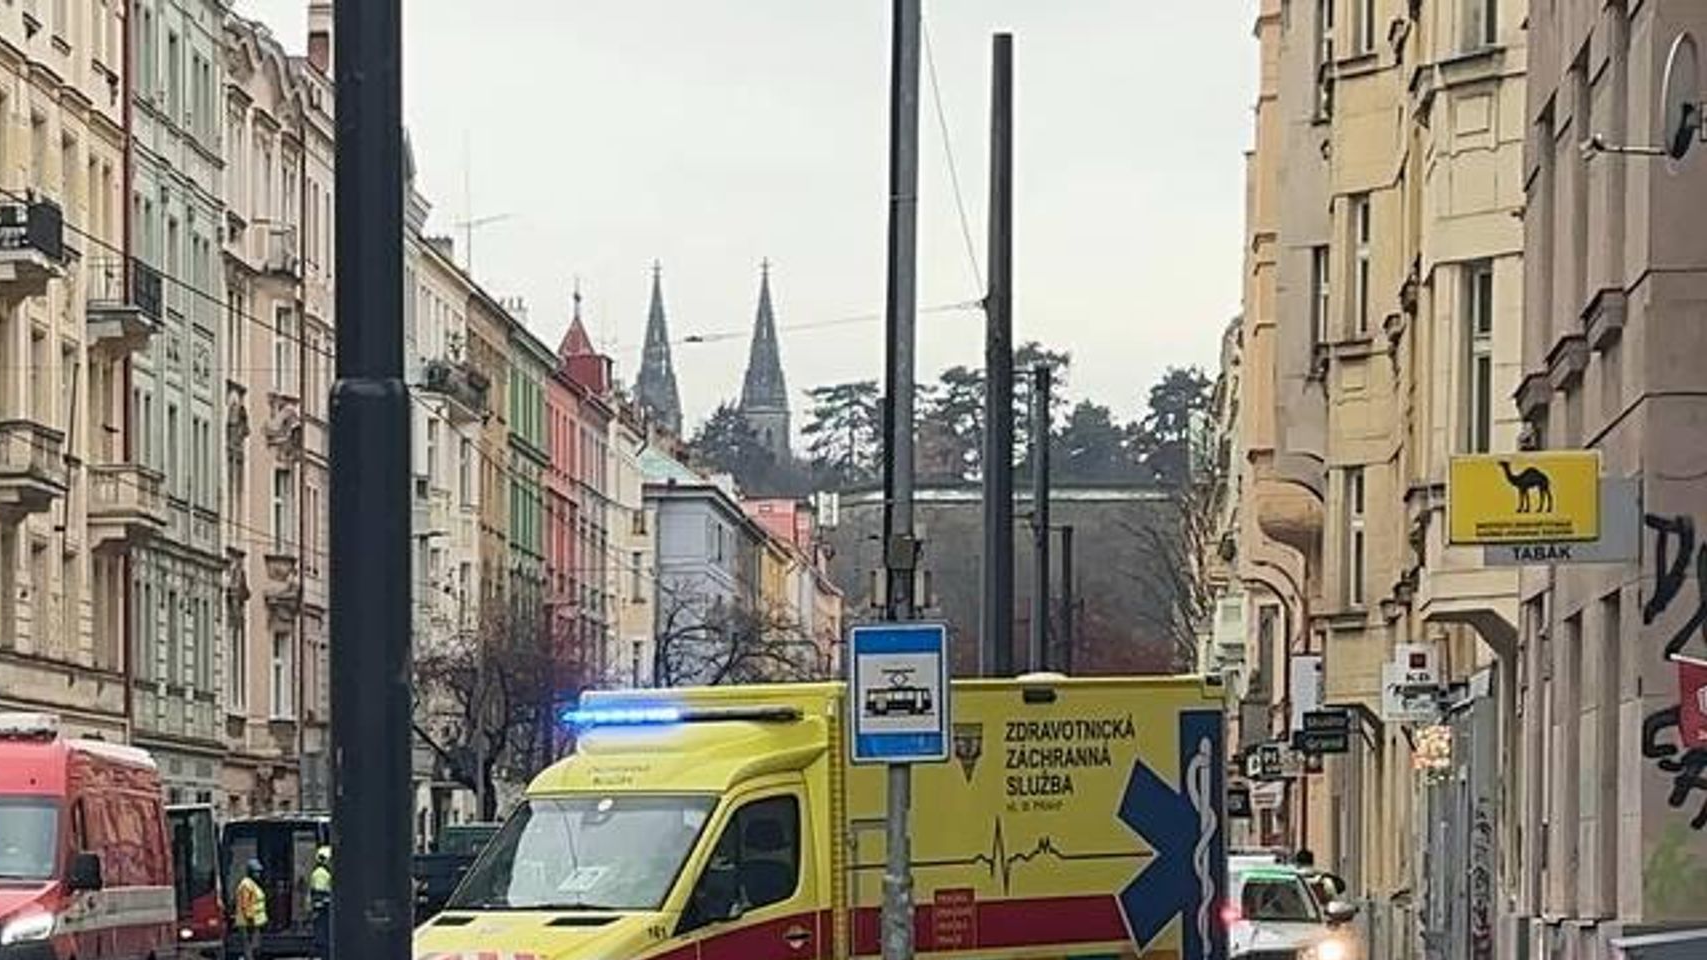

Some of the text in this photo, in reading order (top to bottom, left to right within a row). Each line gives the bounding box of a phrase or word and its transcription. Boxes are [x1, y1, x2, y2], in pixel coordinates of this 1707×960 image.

[1005, 713, 1136, 742] ZDRAVOTNICKÁ
[1005, 741, 1112, 769] ZÁCHRANNÁ
[1006, 770, 1074, 796] SLUŽBA
